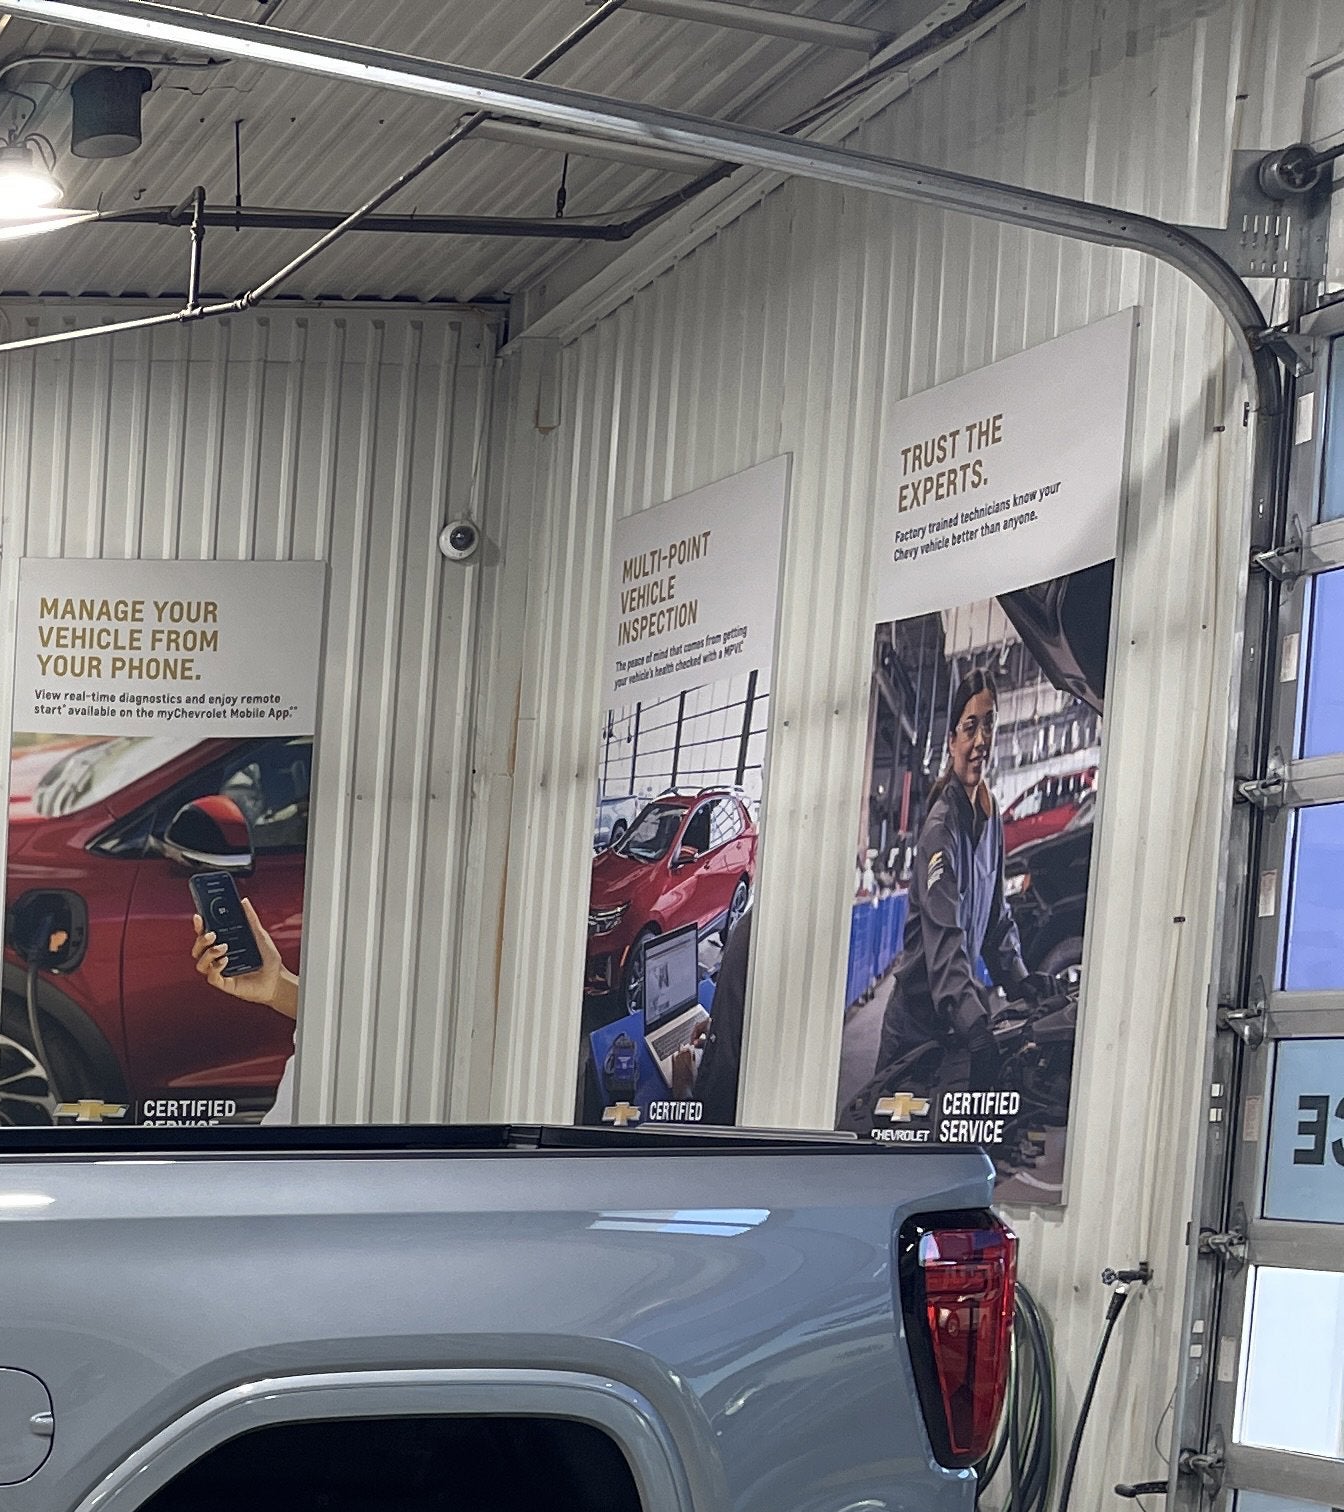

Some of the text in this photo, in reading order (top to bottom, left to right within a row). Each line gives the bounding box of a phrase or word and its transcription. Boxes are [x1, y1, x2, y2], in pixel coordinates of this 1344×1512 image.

[901, 413, 1003, 476] TRUST THE
[898, 459, 988, 513] EXPERTS.
[895, 481, 1062, 543] Factory trained technicians know your
[894, 510, 1038, 561] Chevy vehicle better than anyone.
[622, 530, 711, 584] MULTI-POINT
[621, 575, 676, 614] VEHICLE
[40, 597, 218, 623] MANAGE YOUR
[618, 599, 698, 646] INSPECTION
[38, 625, 219, 652] VEHICLE FROM
[37, 654, 202, 680] YOUR PHONE.
[35, 689, 281, 706] View real-time diagnostics and enjoy remote
[68, 706, 116, 716] available
[120, 709, 132, 717] on
[136, 707, 154, 718] the
[157, 708, 227, 720] myChevrolet
[230, 708, 265, 719] Mobile
[143, 1100, 236, 1117] CERTIFIED
[649, 1101, 703, 1120] CERTIFIED
[943, 1092, 1020, 1115] CERTIFIED
[871, 1129, 930, 1141] CHEVROLET
[940, 1120, 1004, 1143] SERVICE
